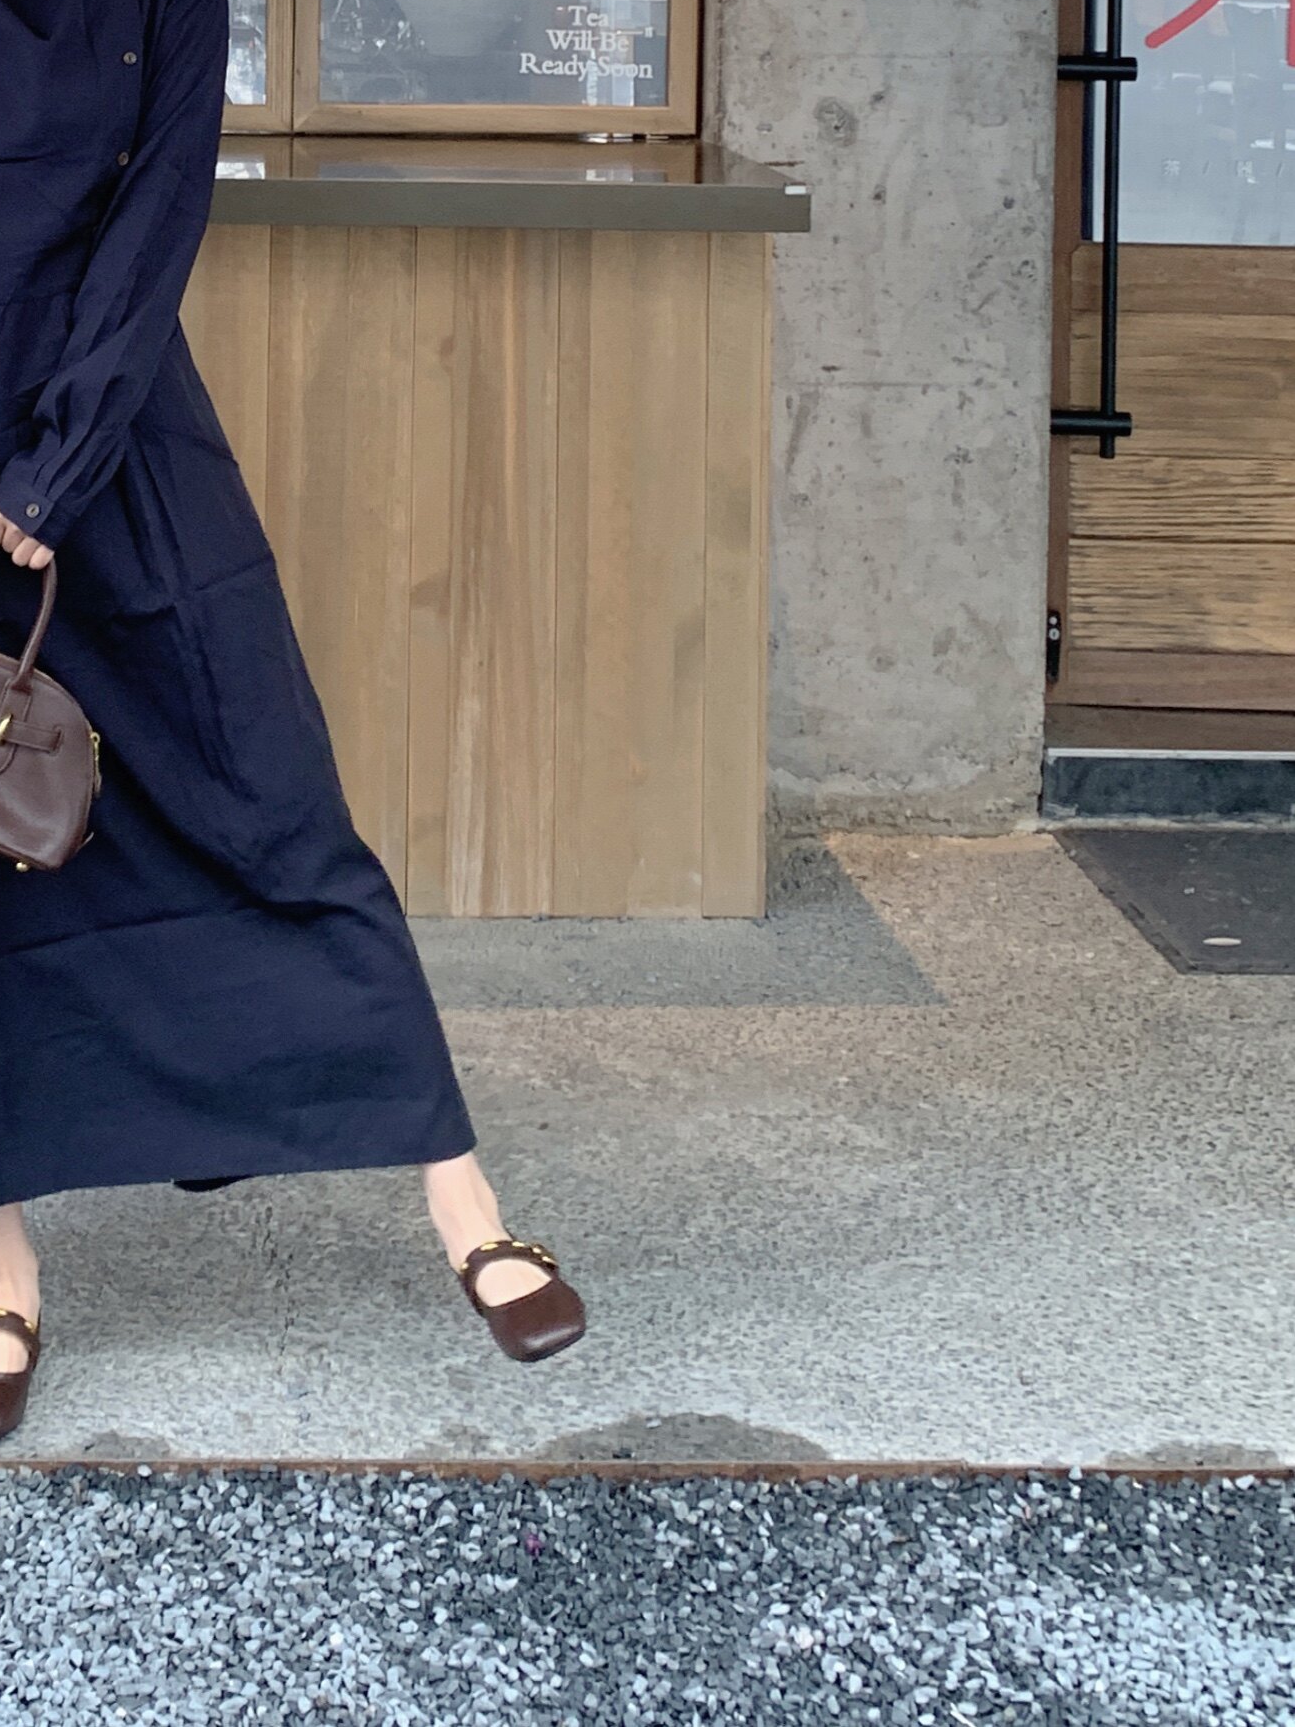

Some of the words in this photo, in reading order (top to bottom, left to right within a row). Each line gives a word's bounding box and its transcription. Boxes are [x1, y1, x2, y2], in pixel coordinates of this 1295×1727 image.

[568, 5, 609, 27] Tea
[545, 29, 592, 52] Will
[600, 30, 630, 53] Be
[519, 52, 589, 82] Ready
[598, 55, 653, 79] Soon
